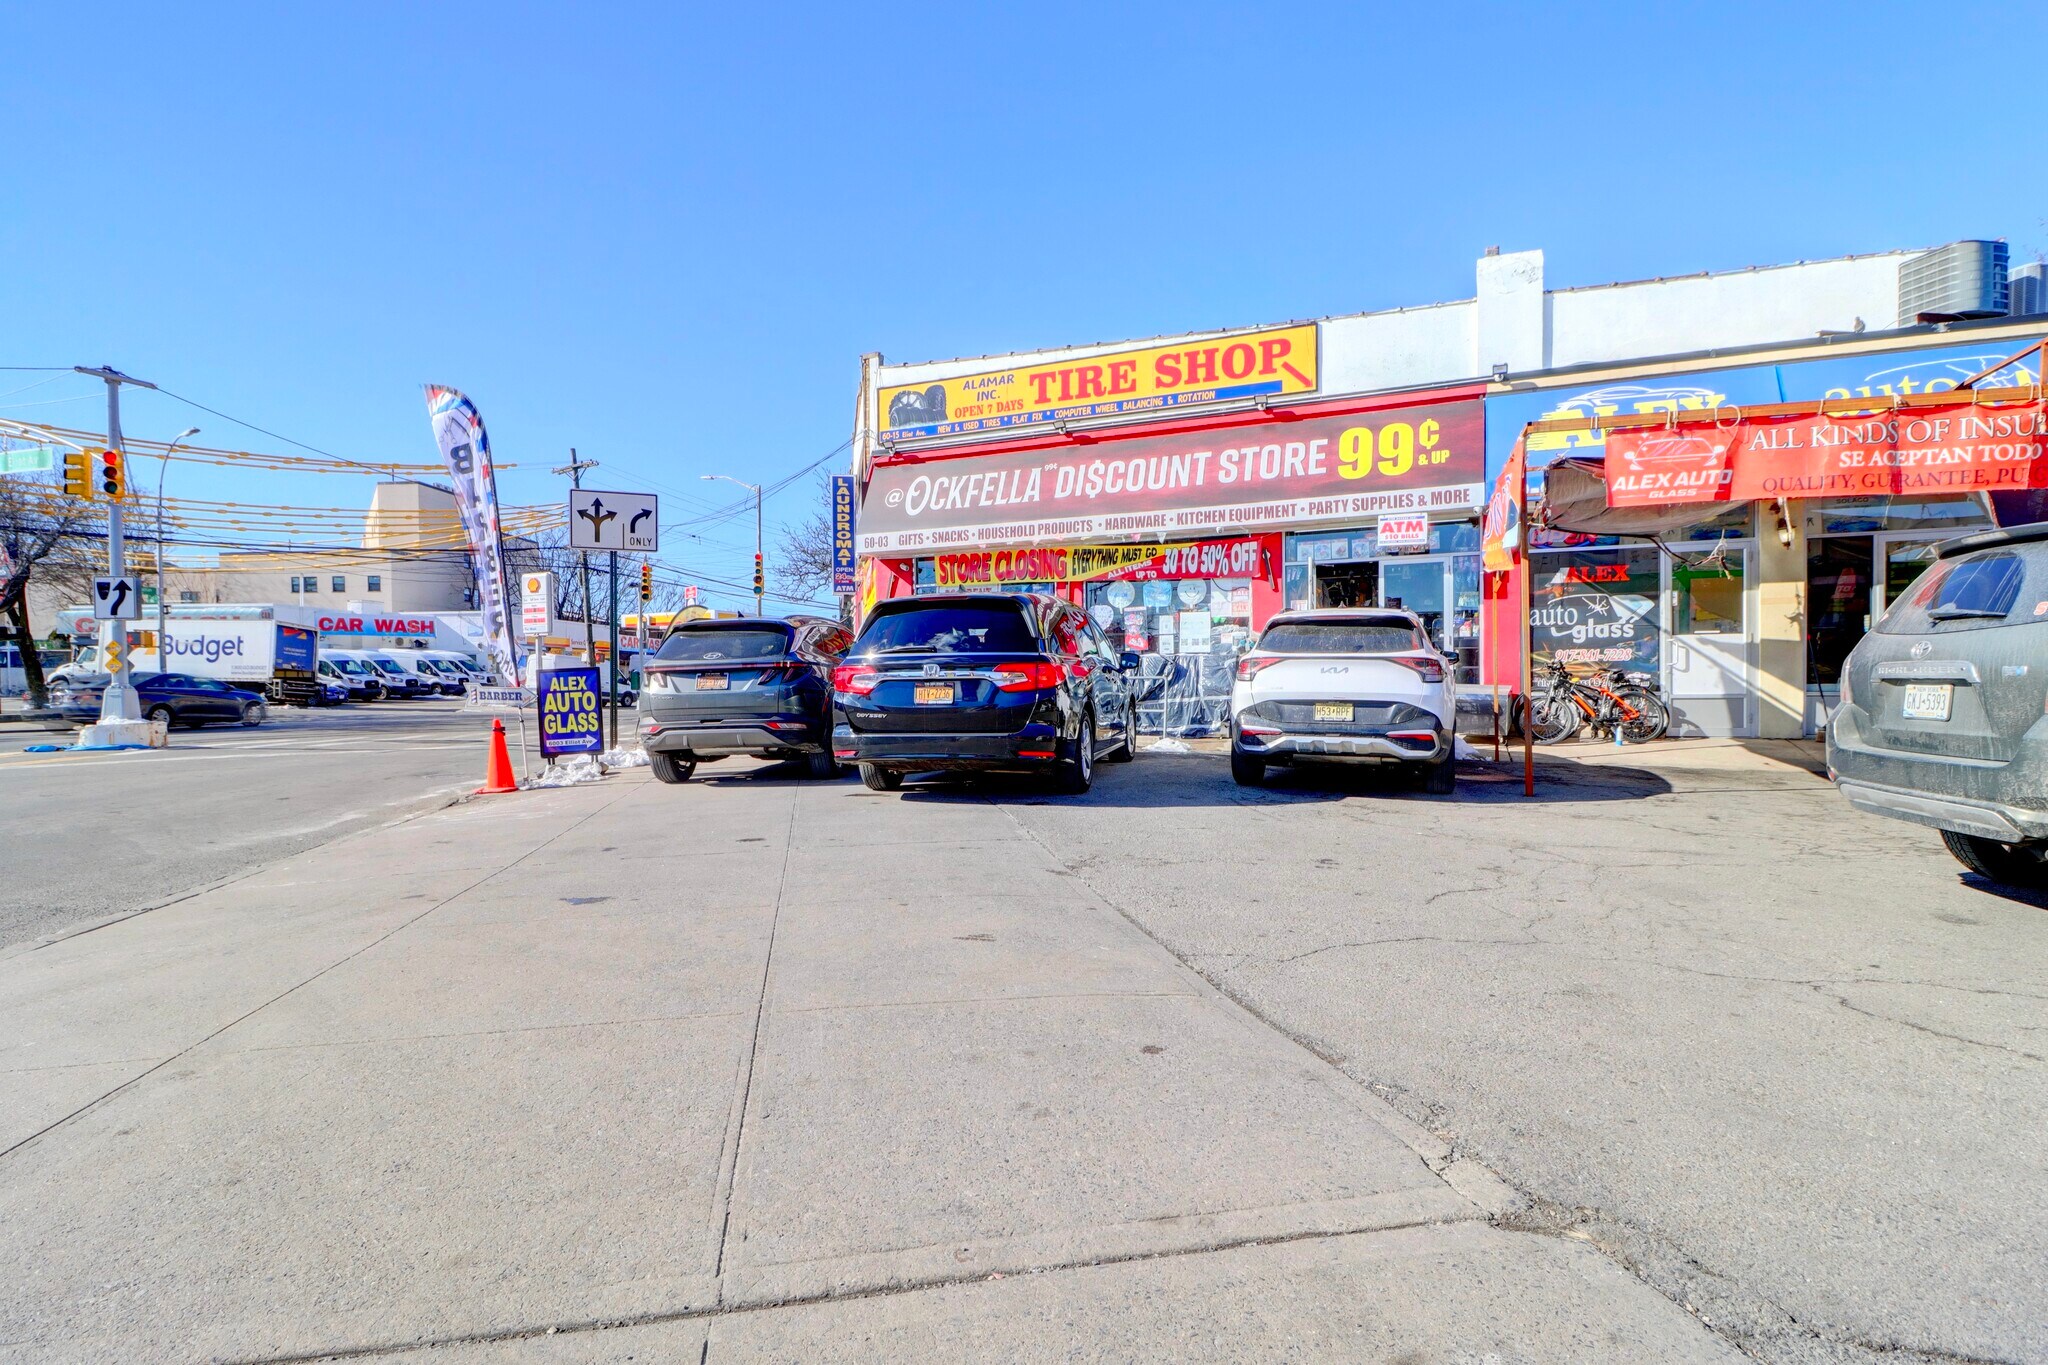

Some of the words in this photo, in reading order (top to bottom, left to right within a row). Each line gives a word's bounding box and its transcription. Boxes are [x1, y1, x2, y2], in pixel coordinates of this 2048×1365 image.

[963, 374, 1014, 390] ALAMAR
[1029, 359, 1136, 405] TIRE
[1155, 338, 1292, 389] SHOP
[976, 390, 1000, 401] INC.
[882, 432, 899, 440] 60-15
[937, 425, 951, 434] NEW
[955, 423, 960, 431] &
[963, 421, 979, 430] USED
[982, 418, 1000, 428] TIRES
[1012, 414, 1028, 424] FLAT
[1032, 412, 1043, 421] FIX
[1054, 406, 1091, 419] COMPUTER
[1095, 403, 1118, 414] WHEEL
[1122, 397, 1163, 409] BALANCING
[1167, 396, 1173, 404] &
[1177, 390, 1216, 403] ROTATION
[954, 402, 984, 418] OPEN
[987, 404, 993, 414] 7
[998, 399, 1024, 413] DAYS
[1749, 427, 1804, 451] ALL
[1810, 420, 1899, 448] KINDS
[1906, 418, 1951, 443] OF
[1418, 453, 1429, 466] &
[1431, 449, 1450, 464] UP
[1839, 450, 1865, 468] SE
[1867, 446, 1972, 468] ACEPTAN
[1054, 451, 1212, 499] DI$COUNT
[1218, 438, 1329, 484] STORE
[1612, 473, 1670, 491] ALEX
[1673, 469, 1733, 487] AUTO
[1762, 474, 1857, 495] QUALITY,
[1648, 488, 1698, 498] GLASS
[836, 477, 852, 566] LAUNDROMAT
[864, 536, 889, 549] 60-03
[898, 532, 924, 546] GIFTS
[931, 529, 969, 544] SNACKS
[977, 524, 1035, 541] HOUSEHOLD
[1037, 519, 1093, 536] PRODUCTS
[1105, 514, 1167, 531] HARDWARE
[1176, 509, 1226, 526] KITCHEN
[1228, 503, 1297, 523] EQUIPMENT
[1308, 499, 1348, 516] PARTY
[1352, 493, 1414, 512] SUPPLIES
[1418, 494, 1428, 507] &
[1431, 488, 1471, 505] MORE
[1380, 521, 1424, 534] ATM
[629, 536, 652, 547] ONLY
[938, 552, 991, 585] STORE
[994, 548, 1067, 581] CLOSING
[1072, 548, 1119, 576] EVERYTHING
[1120, 548, 1142, 563] MUST
[1145, 547, 1157, 558] GO
[1181, 547, 1198, 572] TO
[1200, 543, 1229, 576] 50%
[1231, 541, 1258, 573] OFF
[1107, 569, 1125, 579] ALL
[1125, 560, 1152, 573] ITEMS
[1145, 570, 1157, 578] TO
[1565, 565, 1630, 583] ALEX
[318, 616, 364, 633] CAR
[374, 618, 434, 634] WASH
[1530, 604, 1578, 626] auto
[1572, 618, 1634, 643] glass
[163, 634, 244, 663] Budget
[621, 636, 638, 648] CAR
[1555, 648, 1632, 662] 917-841-7228
[550, 676, 587, 691] ALEX
[480, 691, 522, 701] BARBER
[544, 691, 596, 713] AUTO
[543, 712, 598, 734] GLASS
